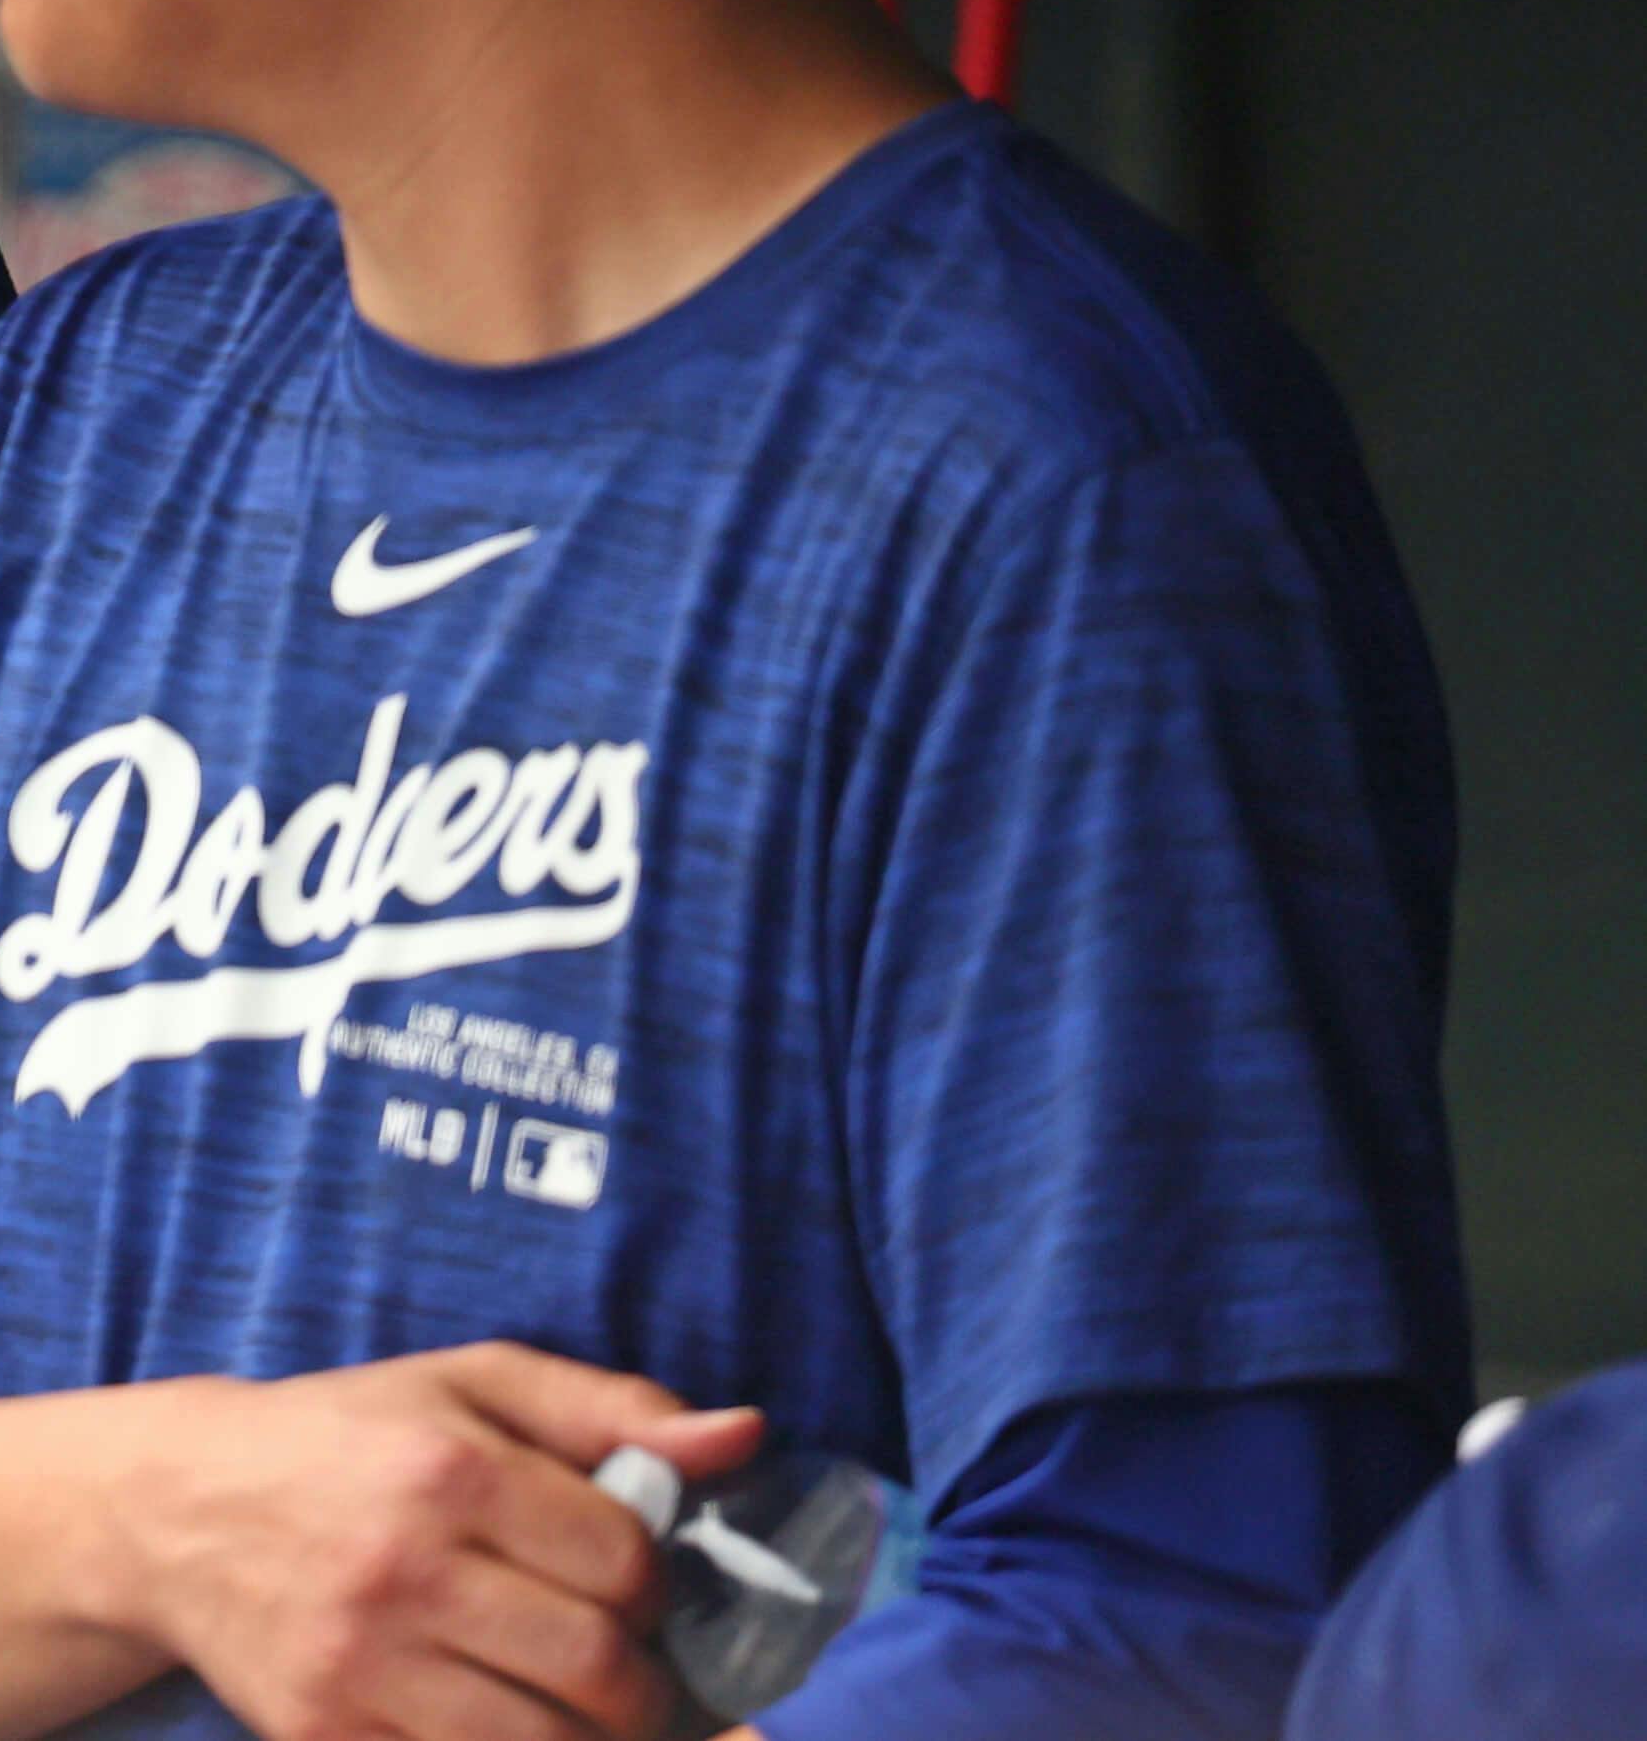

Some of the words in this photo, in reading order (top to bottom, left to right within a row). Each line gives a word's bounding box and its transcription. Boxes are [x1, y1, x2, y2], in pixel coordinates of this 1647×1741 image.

[407, 1001, 458, 1039] LOS
[460, 1045, 618, 1118] COLLECTION
[378, 1096, 467, 1166] MLB
